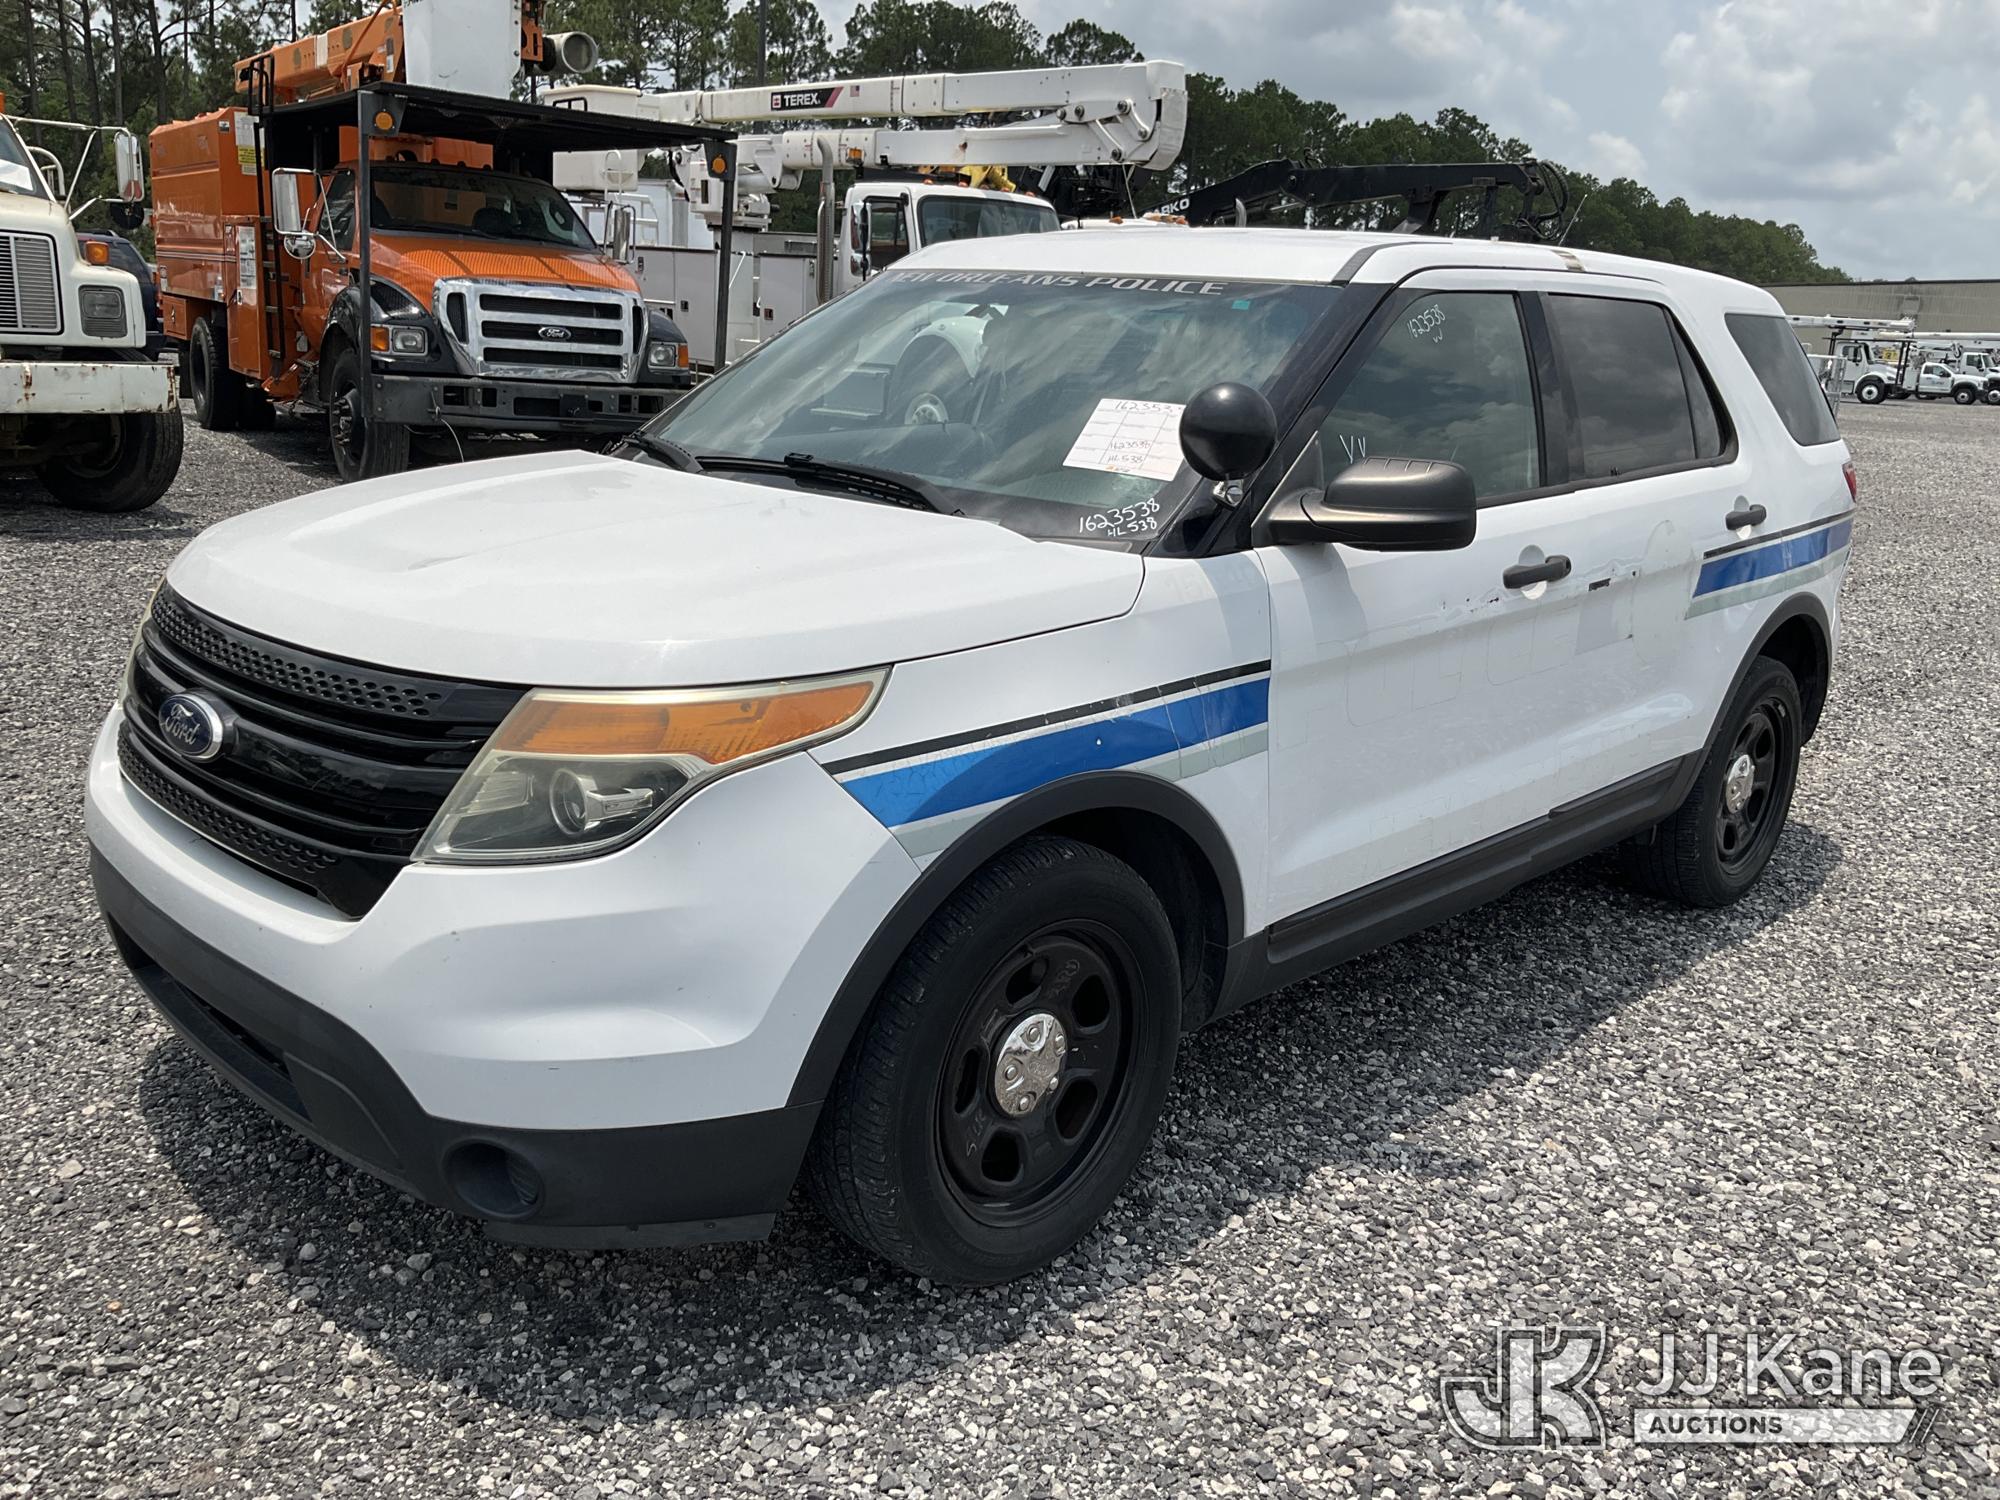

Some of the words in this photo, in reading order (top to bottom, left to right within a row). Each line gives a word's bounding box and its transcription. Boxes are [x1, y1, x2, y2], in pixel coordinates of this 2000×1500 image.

[783, 93, 819, 107] TEREX
[935, 272, 1080, 288] ORLEANS
[1085, 277, 1229, 296] POLICE
[1115, 401, 1183, 413] 162353
[1079, 497, 1160, 533] 1623538
[1107, 527, 1128, 537] HL
[1126, 516, 1157, 532] 538
[160, 703, 200, 745] Ford
